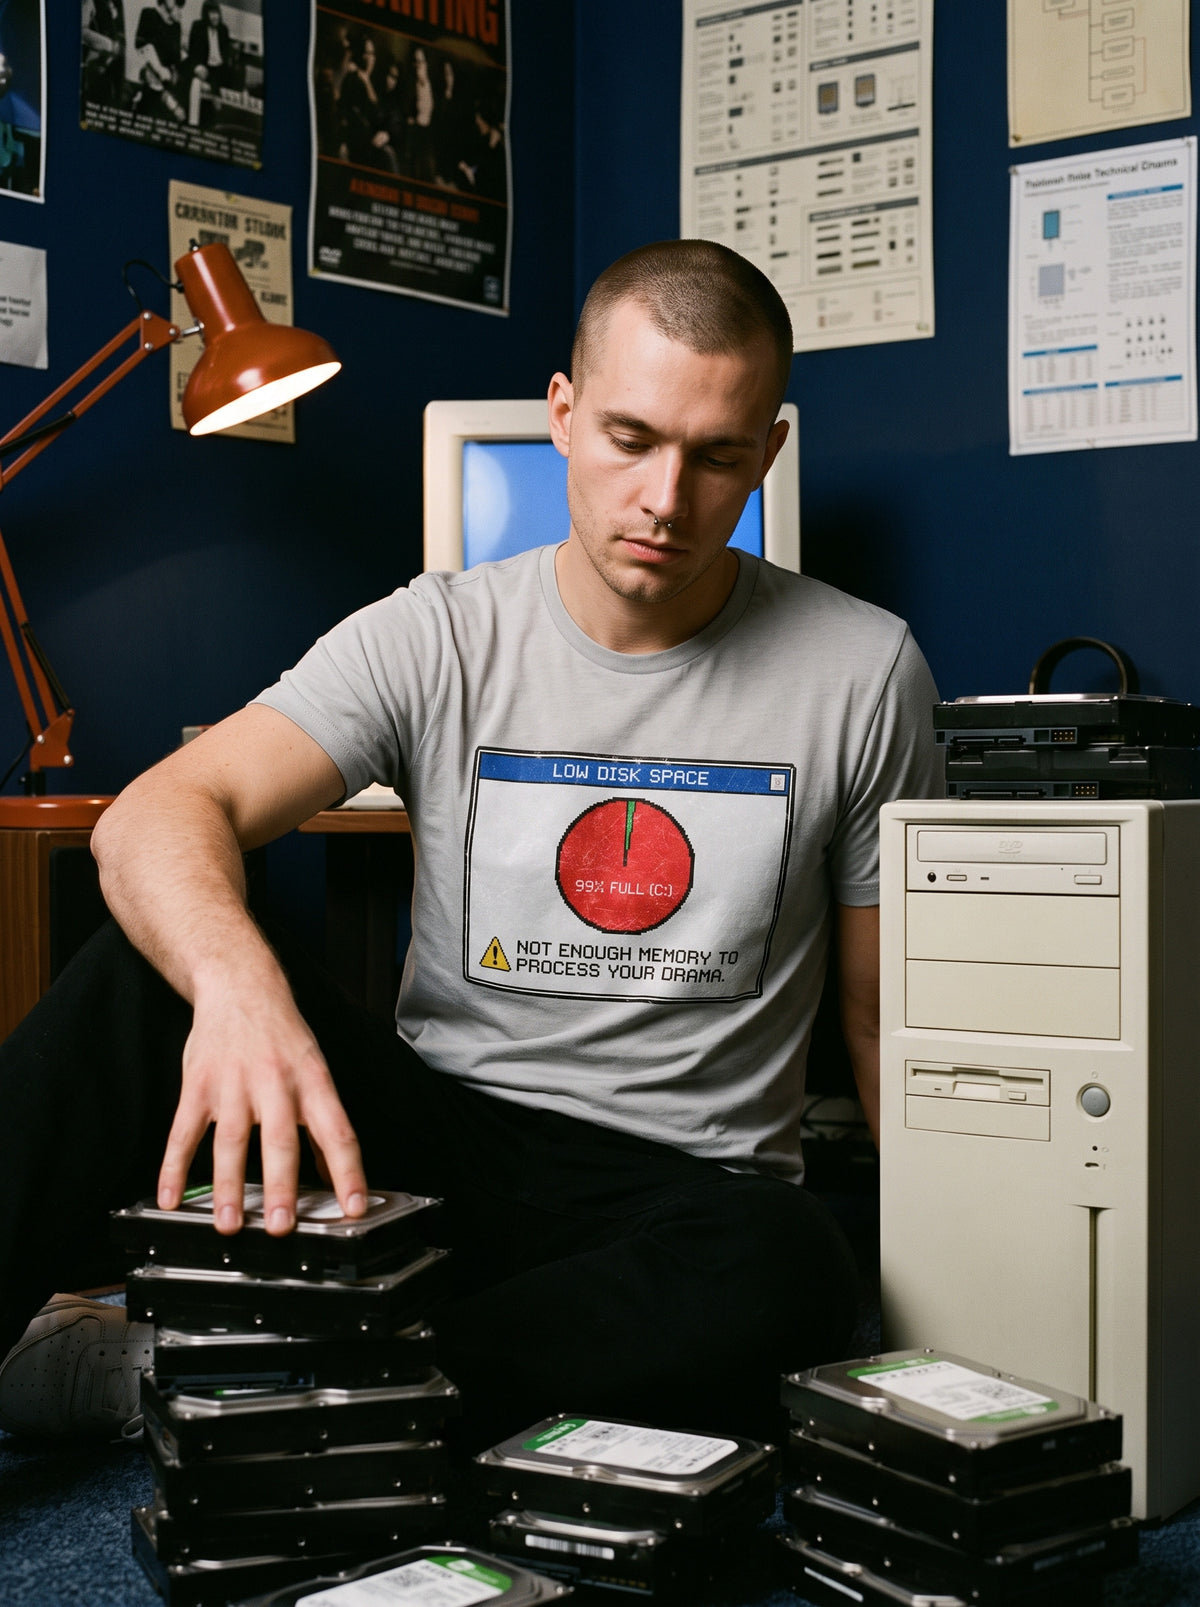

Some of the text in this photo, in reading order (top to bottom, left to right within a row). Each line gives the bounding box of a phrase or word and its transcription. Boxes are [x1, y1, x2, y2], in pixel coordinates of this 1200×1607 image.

[552, 763, 710, 786] LOW DISK SPACE
[575, 879, 604, 893] 99%
[609, 881, 645, 895] FULL
[517, 940, 739, 965] NOT ENOUGH MEMORY TO
[516, 958, 725, 983] PROCESS YOUR DRAMA.
